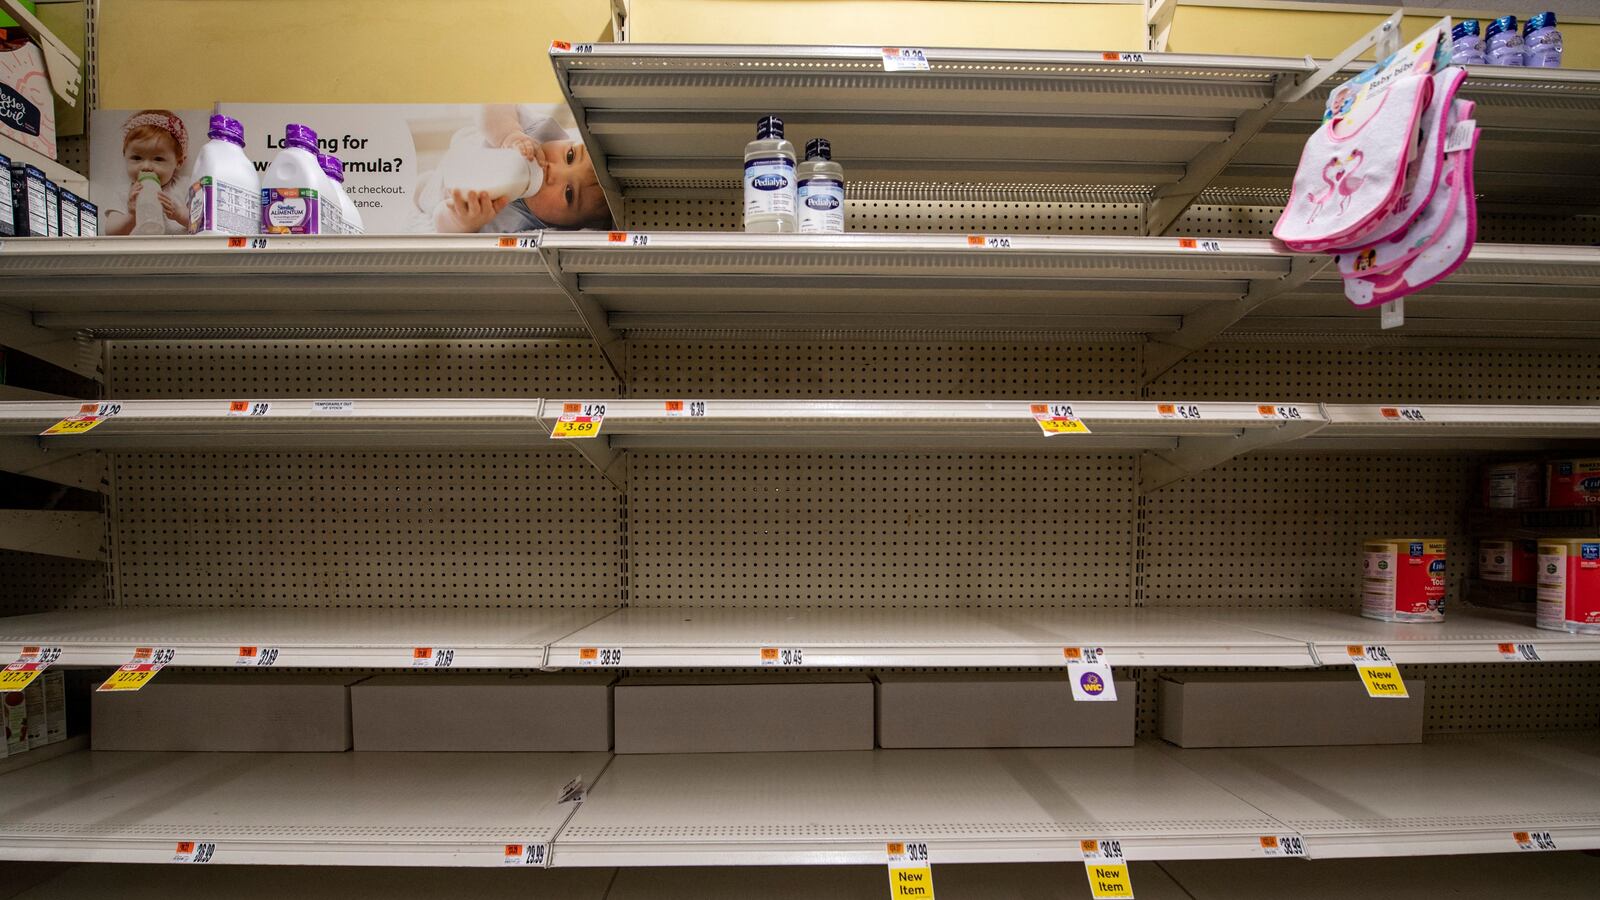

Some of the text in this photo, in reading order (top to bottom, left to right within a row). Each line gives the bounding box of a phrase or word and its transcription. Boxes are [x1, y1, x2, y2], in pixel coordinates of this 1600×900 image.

[0, 91, 26, 114] esser
[343, 135, 368, 149] for
[754, 177, 787, 189] Pedialyte
[346, 185, 405, 194] at checkout.
[807, 197, 839, 208] Pedialyte
[1368, 670, 1392, 679] New
[1083, 683, 1103, 692] WIC
[1372, 681, 1398, 690] Item
[899, 872, 923, 881] New
[1096, 868, 1120, 878] New
[900, 885, 925, 895] Item
[1099, 882, 1124, 892] Item
